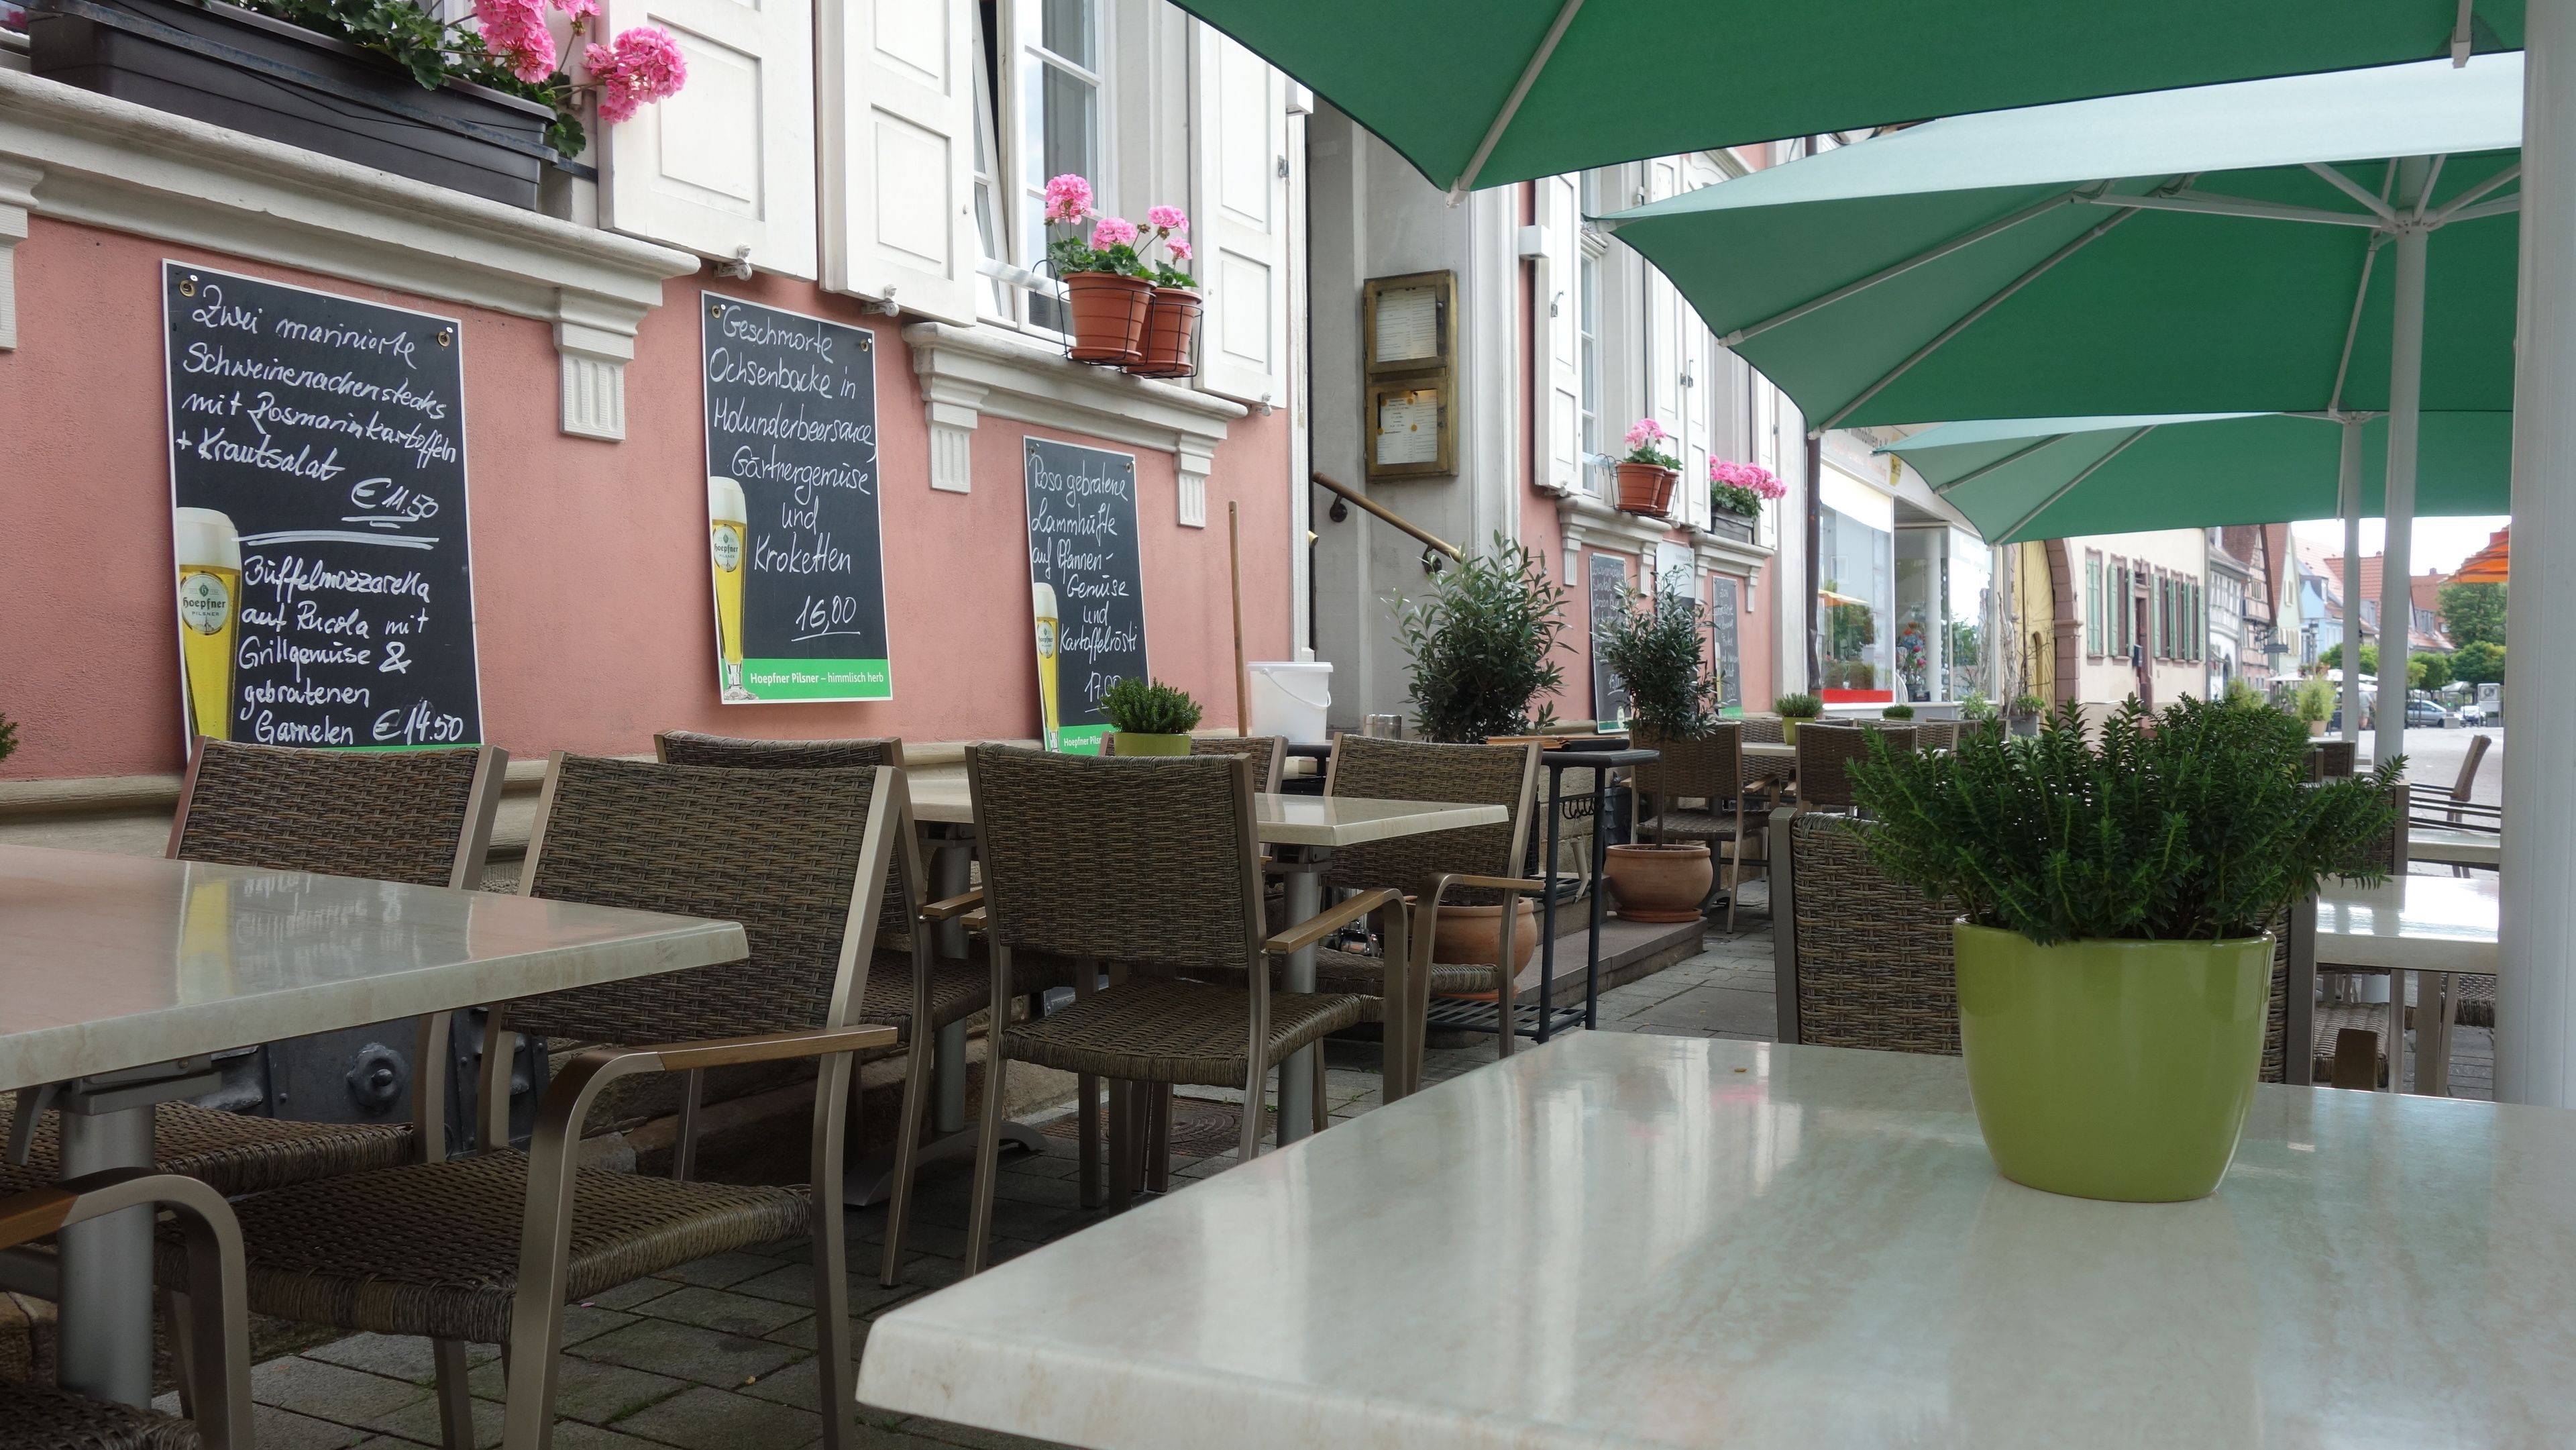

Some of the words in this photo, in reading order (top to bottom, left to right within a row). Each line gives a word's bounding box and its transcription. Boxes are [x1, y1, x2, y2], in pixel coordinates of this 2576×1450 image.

[193, 284, 263, 333] Zwei
[276, 318, 417, 370] marinierte
[722, 305, 833, 364] Geschmorte
[183, 342, 446, 419] Schweinenackensteaks
[710, 347, 833, 399] Ochsenbacke
[840, 366, 856, 399] in
[182, 391, 242, 416] mit
[248, 391, 456, 469] Rosmarinkartoffeln
[176, 430, 192, 450] +
[198, 427, 345, 481] Krautsalat
[732, 444, 871, 505] Gärtnergemüse
[1029, 455, 1062, 491] Rosa
[1066, 460, 1128, 508] gebratene
[782, 495, 819, 535] und
[1031, 497, 1118, 547] Lammhüfte
[754, 532, 851, 574] Kroketten
[1032, 537, 1052, 579] auf
[244, 555, 430, 603] Büffelmozzarella
[1067, 574, 1129, 598] Gemüse
[241, 603, 287, 632] auf
[297, 601, 370, 639] Rucola
[385, 608, 429, 635] mit
[796, 595, 857, 634] 16,00
[1083, 601, 1109, 626] und
[239, 636, 372, 682] Grillgemüse
[379, 641, 412, 674] &
[1060, 621, 1137, 664] Kartoffelrösti
[240, 678, 370, 720] gebratenen
[750, 673, 790, 686] Hoepfner
[792, 672, 819, 684] Pilsner
[828, 672, 866, 683] himmlisch
[867, 672, 883, 682] herb
[255, 709, 354, 744] Garnelen
[1064, 737, 1088, 748] Hoepfner
